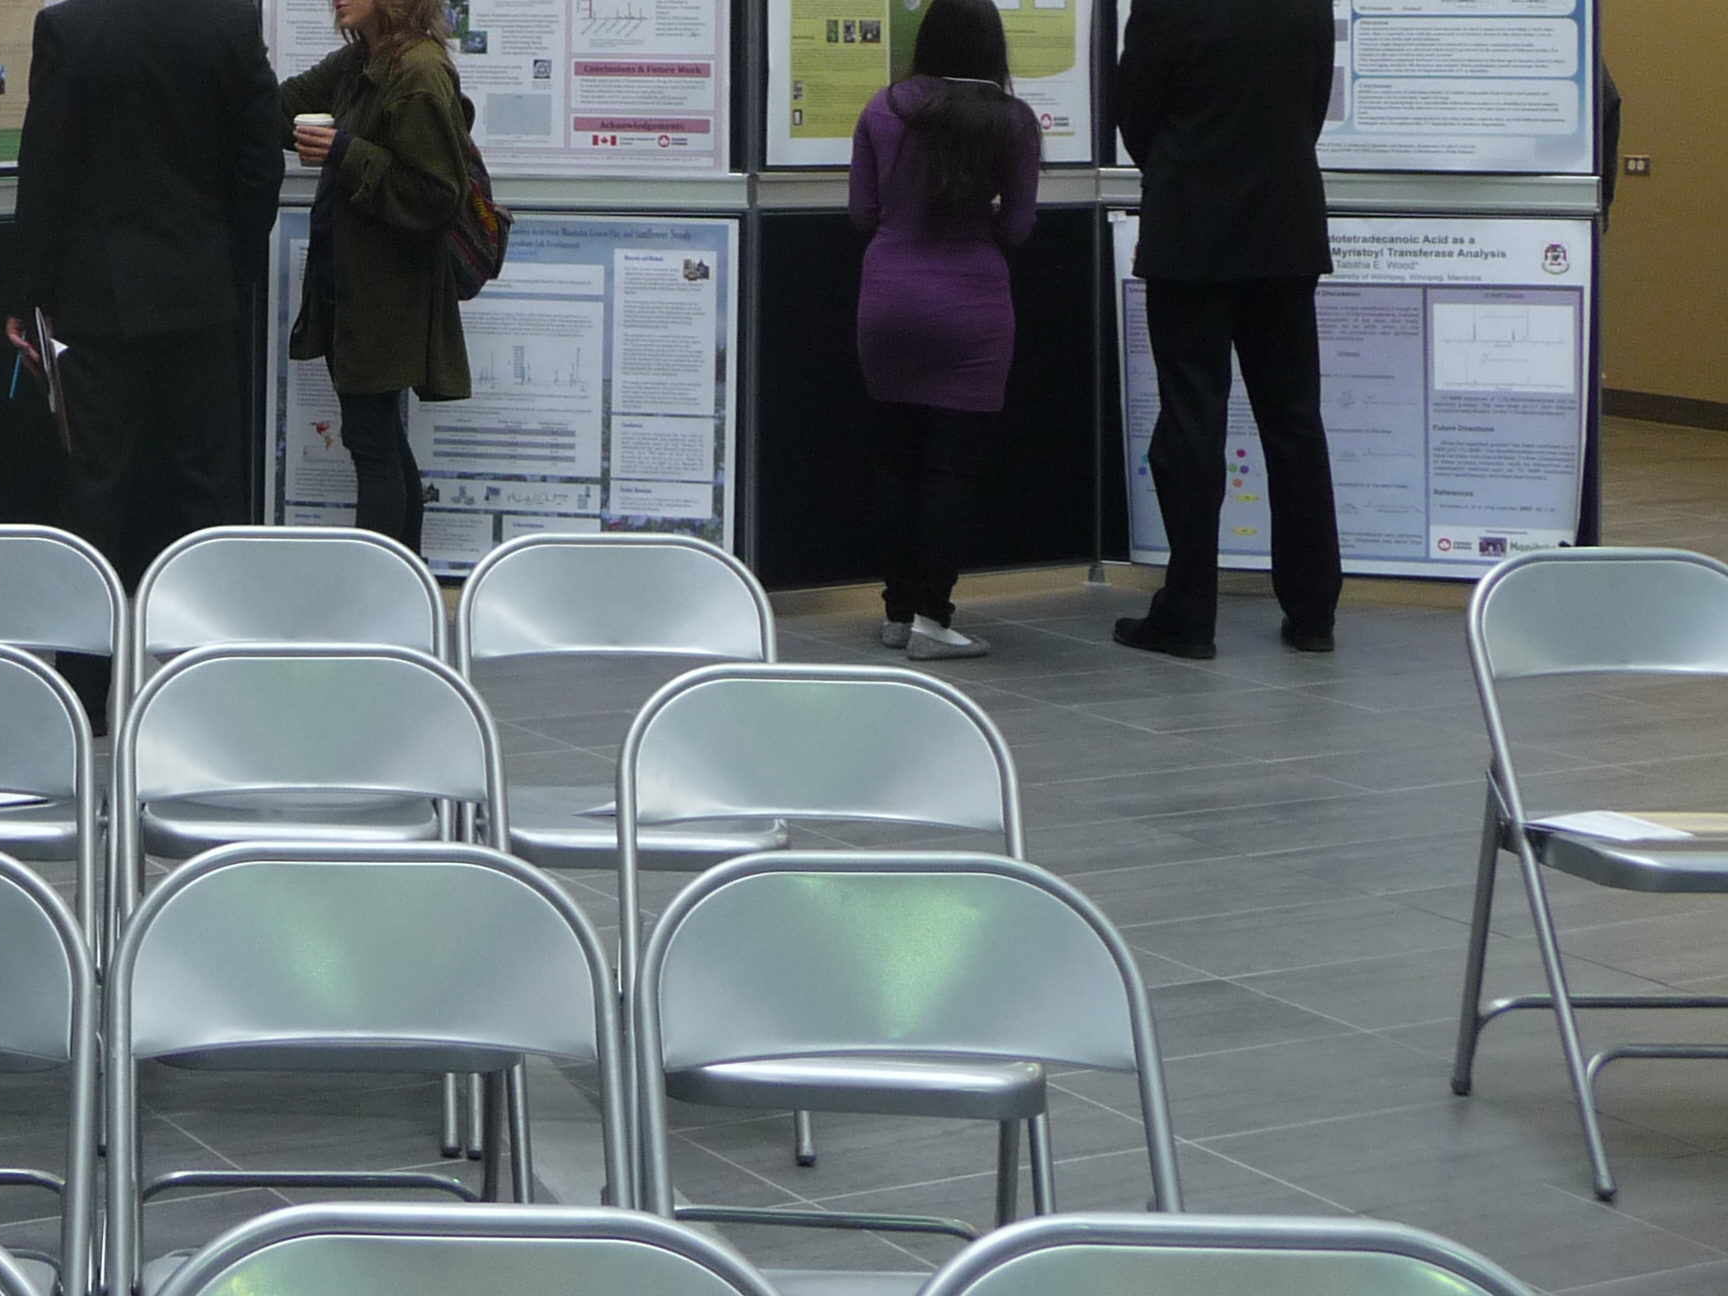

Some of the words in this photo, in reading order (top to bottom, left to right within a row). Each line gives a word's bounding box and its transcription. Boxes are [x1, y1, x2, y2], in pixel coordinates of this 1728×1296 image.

[584, 64, 635, 73] Conclusions
[646, 65, 676, 74] Future
[677, 65, 702, 74] Work
[1329, 234, 1420, 245] dotetradecanoic
[1422, 235, 1449, 245] Acid
[1452, 236, 1465, 245] as
[1469, 237, 1475, 245] a
[1332, 247, 1384, 259] Myristoyl
[1387, 248, 1454, 258] Transferase
[1457, 248, 1507, 261] Analysis
[1336, 260, 1371, 269] Tabitha
[1373, 260, 1381, 269] E.
[1432, 424, 1456, 432] Future
[1457, 425, 1495, 433] Directions
[1433, 489, 1474, 497] References
